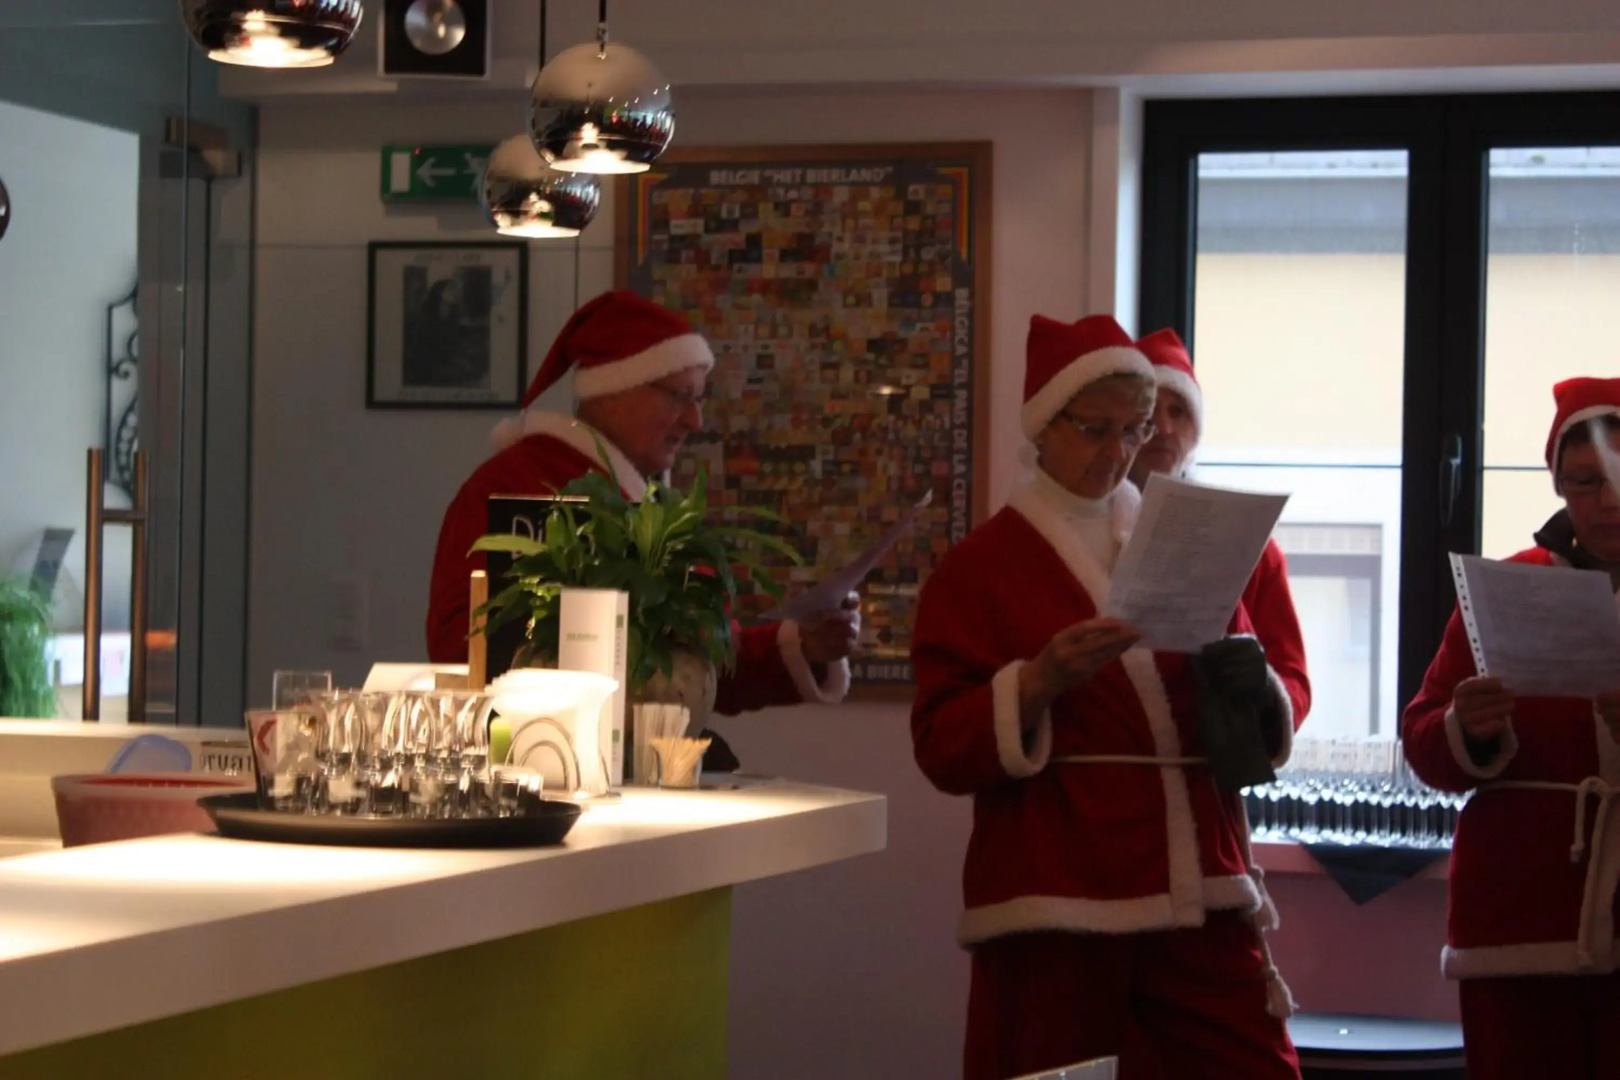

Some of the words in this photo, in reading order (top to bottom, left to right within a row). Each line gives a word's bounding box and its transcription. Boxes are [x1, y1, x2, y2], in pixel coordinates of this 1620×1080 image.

[953, 429, 967, 450] DE
[953, 454, 967, 475] LA
[952, 479, 966, 546] CERVEZ
